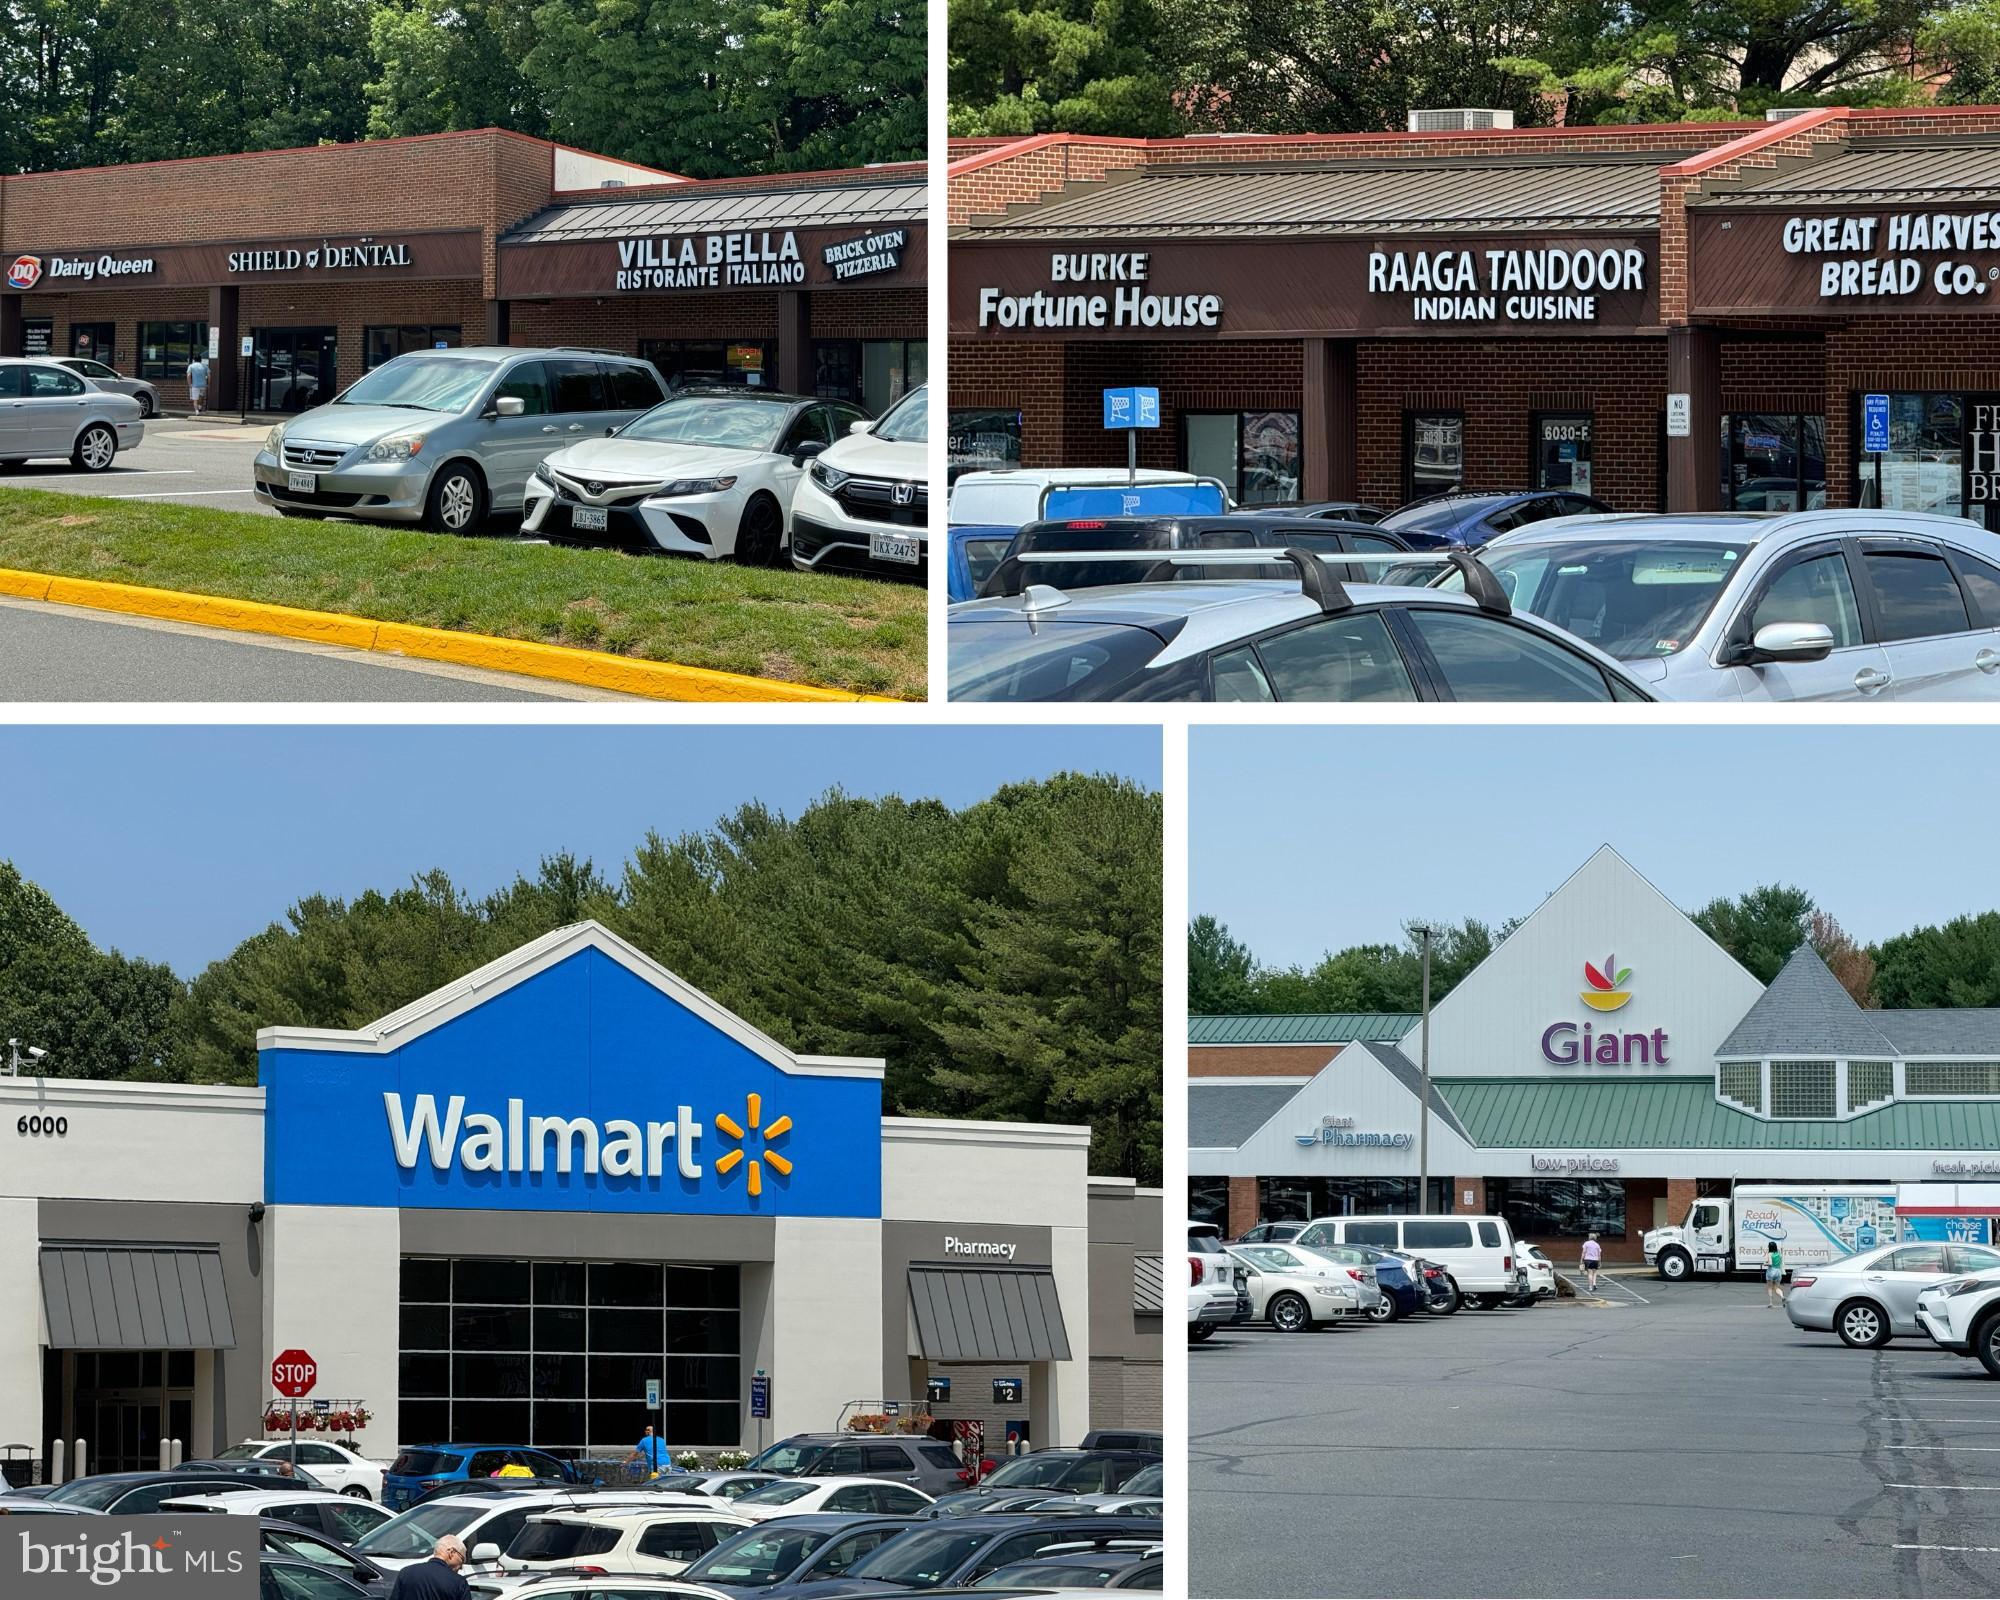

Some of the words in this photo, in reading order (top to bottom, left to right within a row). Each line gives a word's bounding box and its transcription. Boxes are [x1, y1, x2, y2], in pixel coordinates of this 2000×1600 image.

[825, 244, 863, 264] BRICK
[866, 231, 904, 252] OVEN
[1783, 217, 1877, 253] GREAT
[228, 249, 301, 272] SHIELD
[324, 244, 412, 268] DENTAL
[618, 239, 697, 268] VILLA
[706, 231, 799, 266] BELLA
[13, 263, 34, 280] DQ
[50, 258, 95, 280] Dairy
[97, 255, 153, 277] Queen
[616, 266, 719, 290] RISTORANTE
[726, 262, 805, 285] ITALIANO
[836, 253, 897, 279] PIZZERIA
[1051, 253, 1148, 281] BURKE
[1368, 251, 1477, 292] RAAGA
[1486, 249, 1644, 291] TANDOOR
[1820, 258, 1922, 297] BREAD
[979, 287, 1108, 328] Fortune
[1114, 286, 1221, 327] House
[1414, 297, 1496, 321] INDIAN
[1505, 296, 1595, 320] CUISINE
[1674, 399, 1684, 410] NO
[1545, 426, 1589, 441] 6030-F
[873, 540, 916, 557] UKX-2475
[1541, 1022, 1671, 1065] Giant
[17, 1115, 68, 1136] 6000
[1322, 1115, 1354, 1127] Giant
[383, 1092, 703, 1180] Walmart
[1322, 1128, 1415, 1151] Pharmacy
[1741, 1220, 1782, 1230] Refresh
[1745, 1209, 1780, 1221] Ready
[1945, 1219, 1982, 1231] choose
[944, 1236, 1017, 1260] Pharmacy
[274, 1363, 315, 1383] STOP
